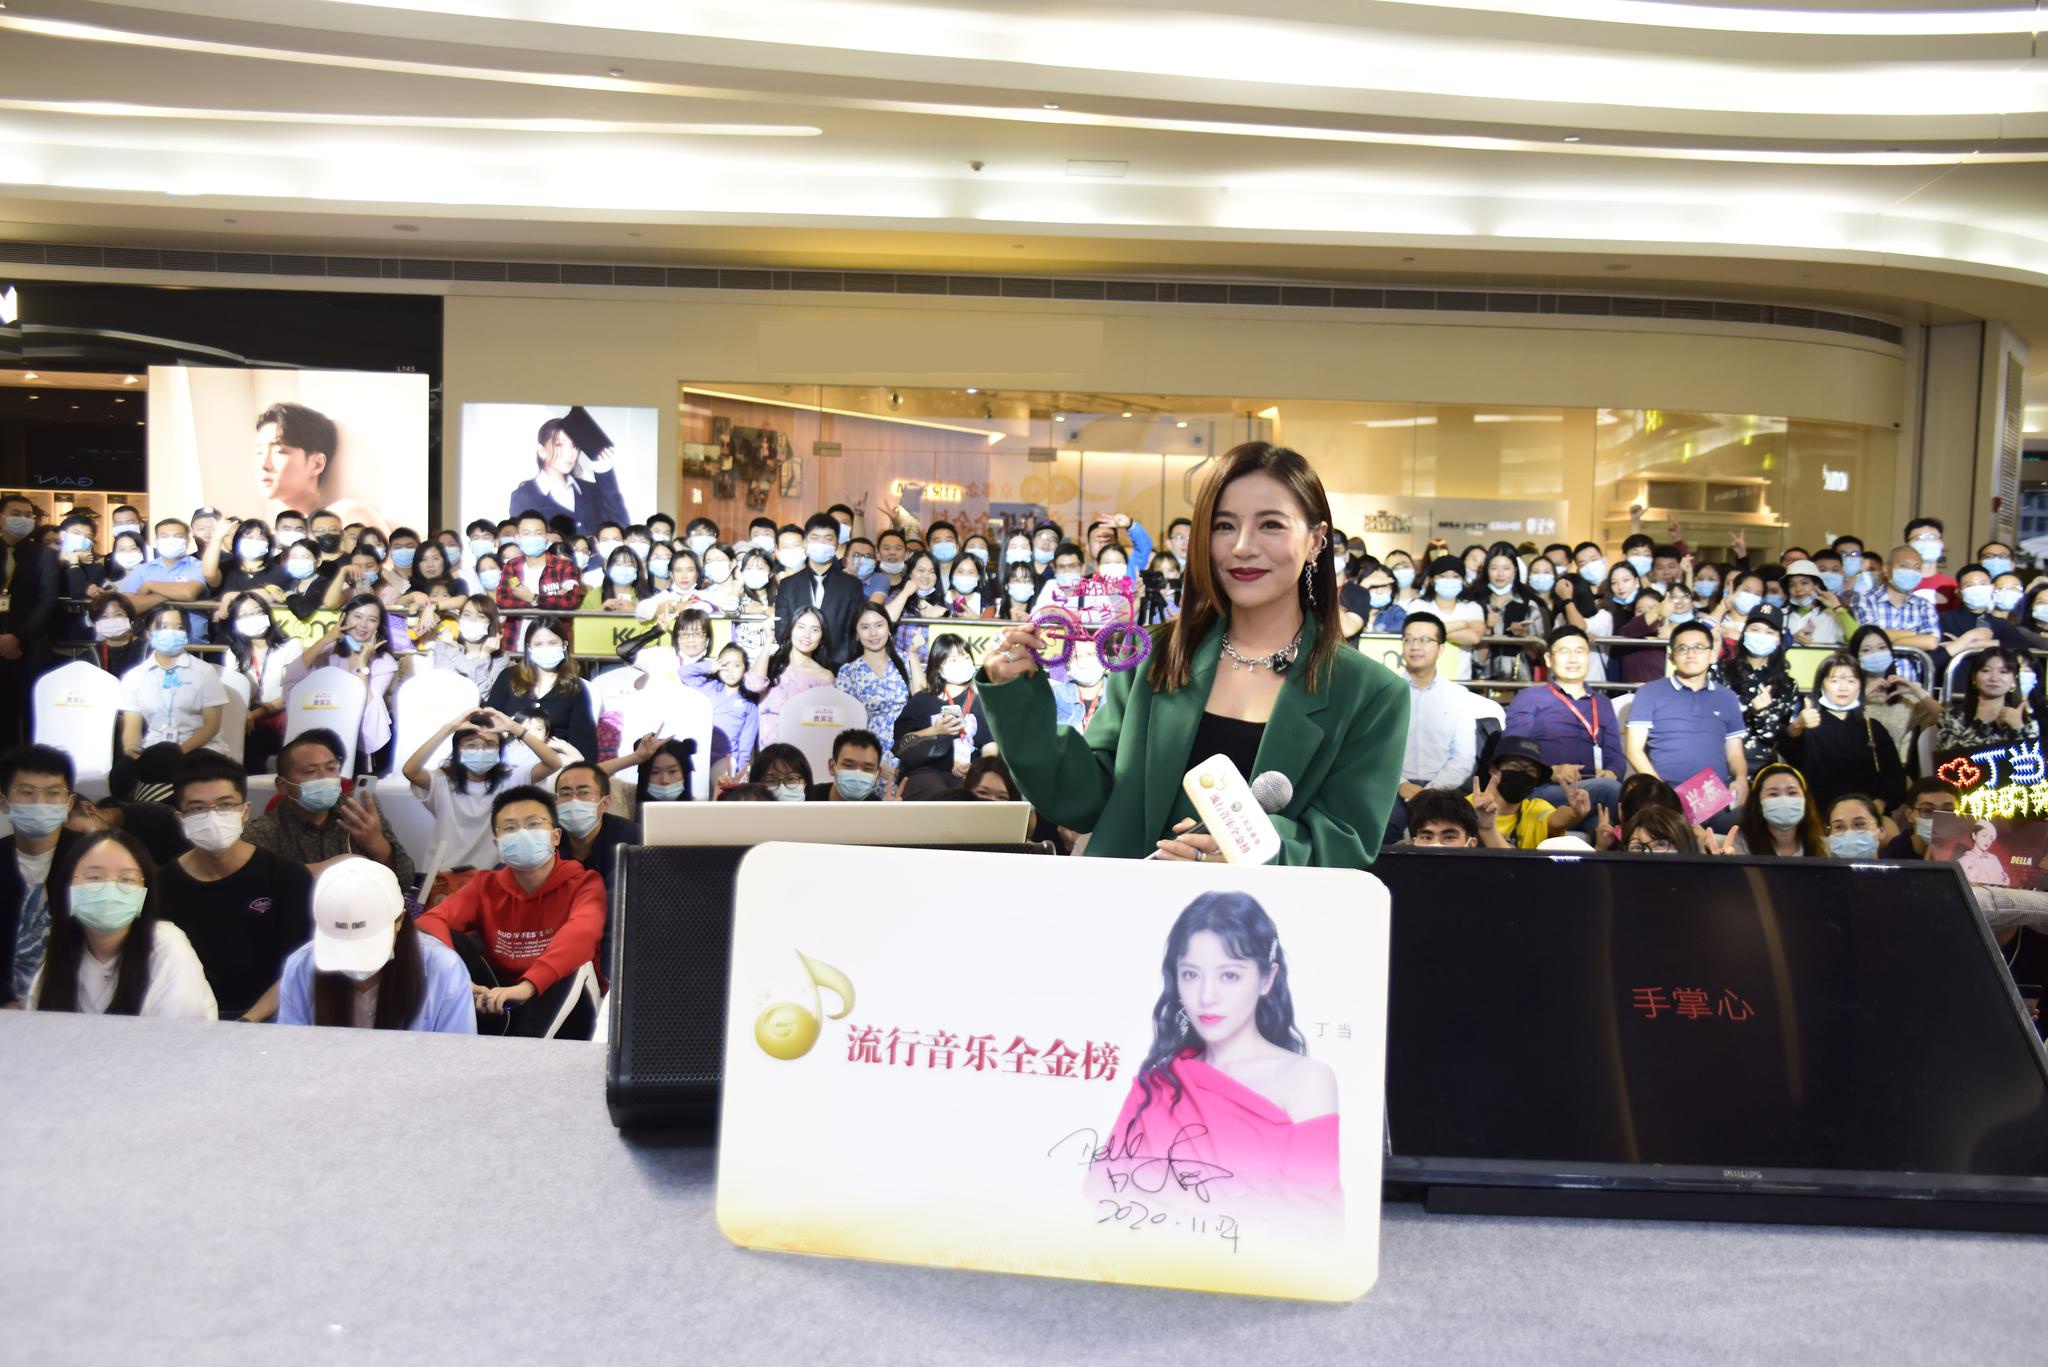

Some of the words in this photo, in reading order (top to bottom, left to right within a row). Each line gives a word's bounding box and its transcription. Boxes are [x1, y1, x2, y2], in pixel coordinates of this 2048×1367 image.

[1969, 739, 2047, 789] 丁当
[2010, 855, 2033, 866] DELLA
[1631, 986, 1755, 1020] 手掌心
[1313, 1021, 1352, 1039] 丁当
[847, 1023, 1121, 1082] 流行音乐全金榜
